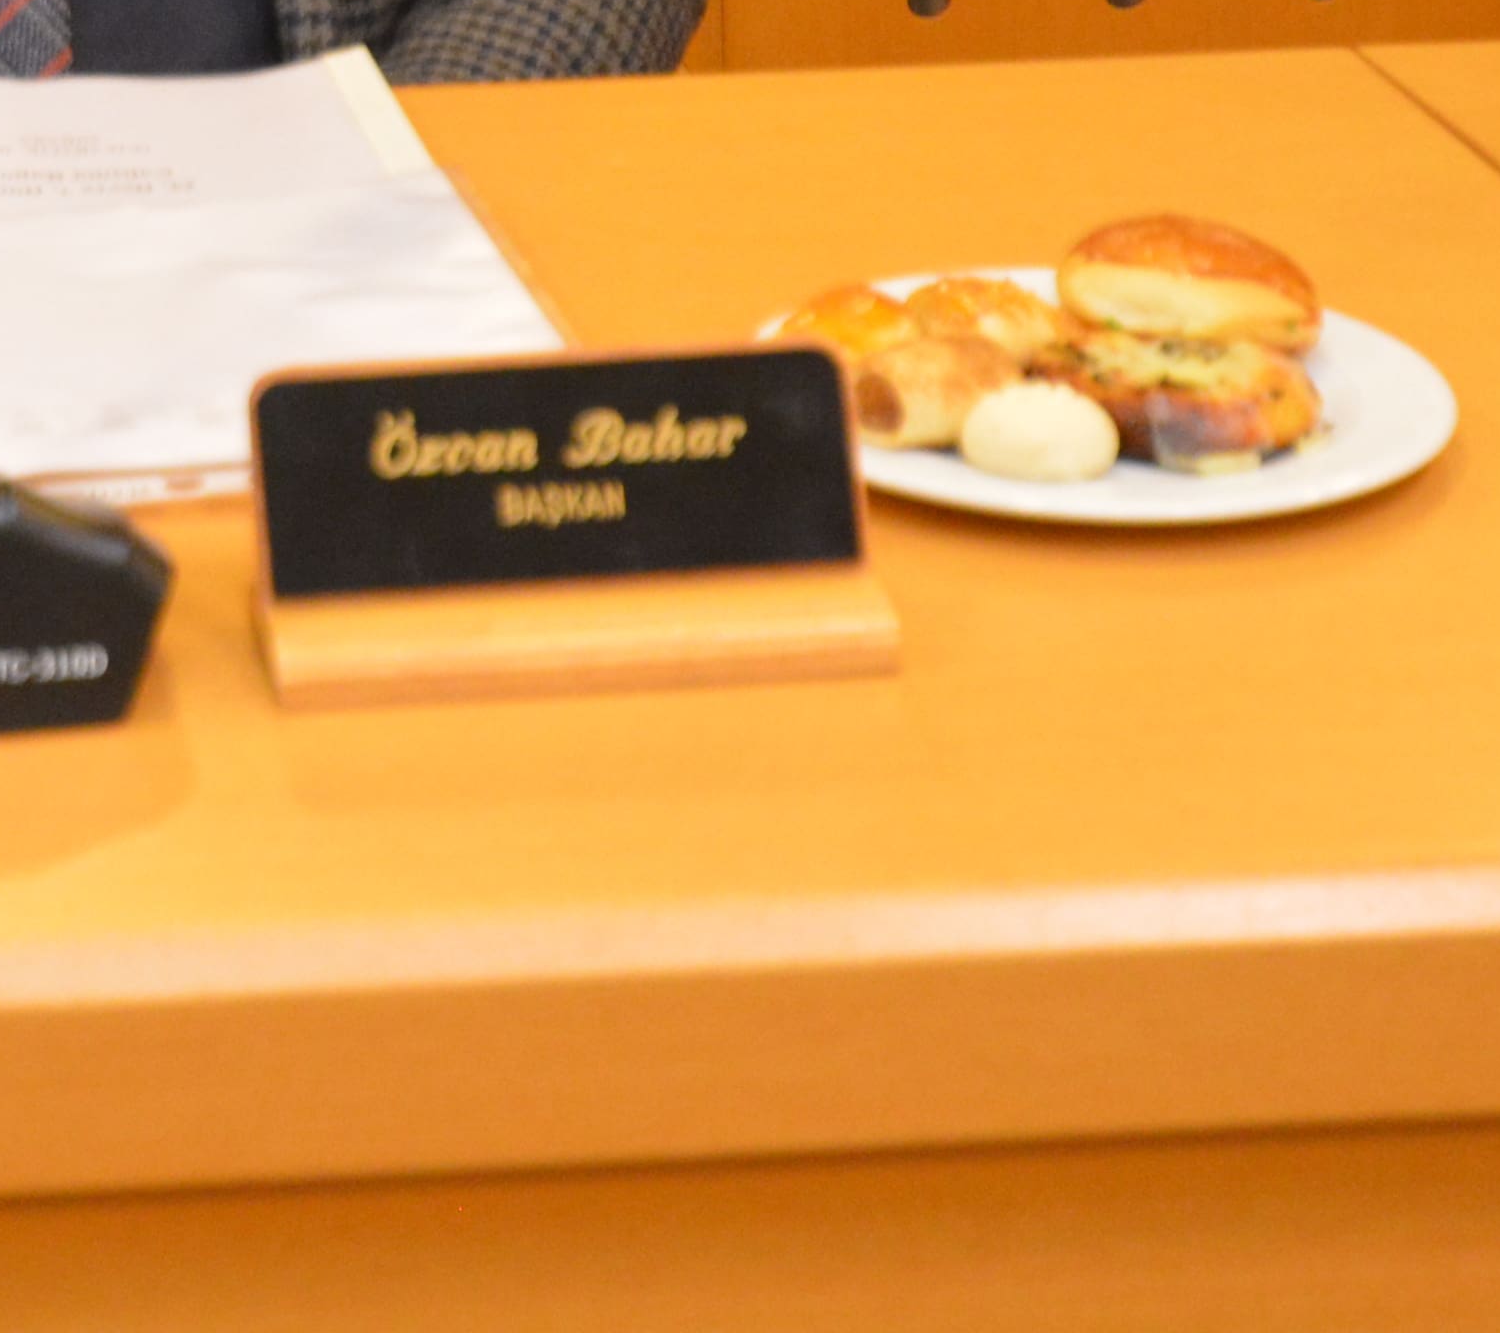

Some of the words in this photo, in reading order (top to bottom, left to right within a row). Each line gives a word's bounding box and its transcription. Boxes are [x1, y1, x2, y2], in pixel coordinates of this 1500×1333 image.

[370, 407, 540, 481] Özcan
[561, 402, 748, 469] Bahar
[495, 479, 627, 529] BAŞKAN
